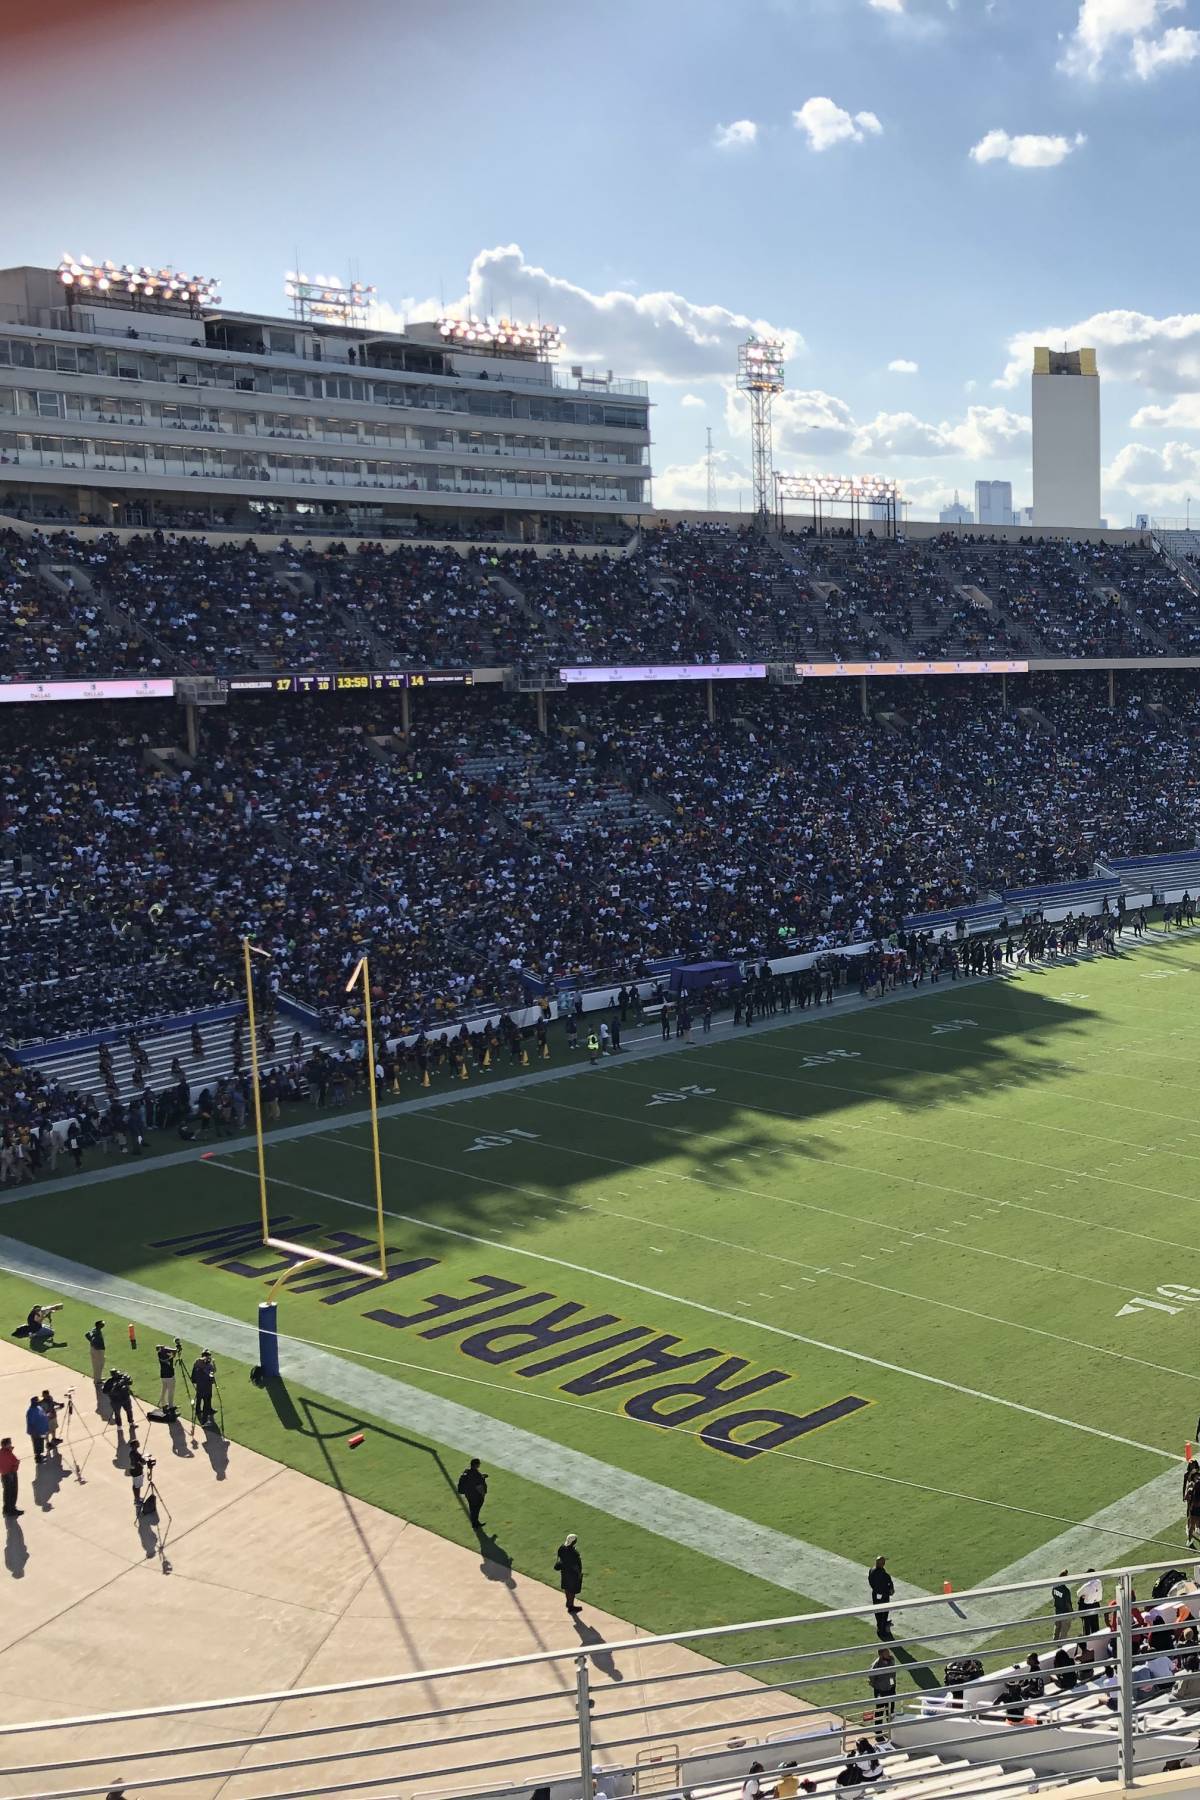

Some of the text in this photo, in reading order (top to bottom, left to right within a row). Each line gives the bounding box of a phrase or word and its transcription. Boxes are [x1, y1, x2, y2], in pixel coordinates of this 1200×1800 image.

[277, 679, 292, 691] 17
[337, 677, 368, 688] 13:59
[411, 675, 424, 686] 14
[651, 1084, 717, 1102] 20
[473, 1128, 543, 1147] 10
[148, 1215, 874, 1461] PRAIRIE VIEW
